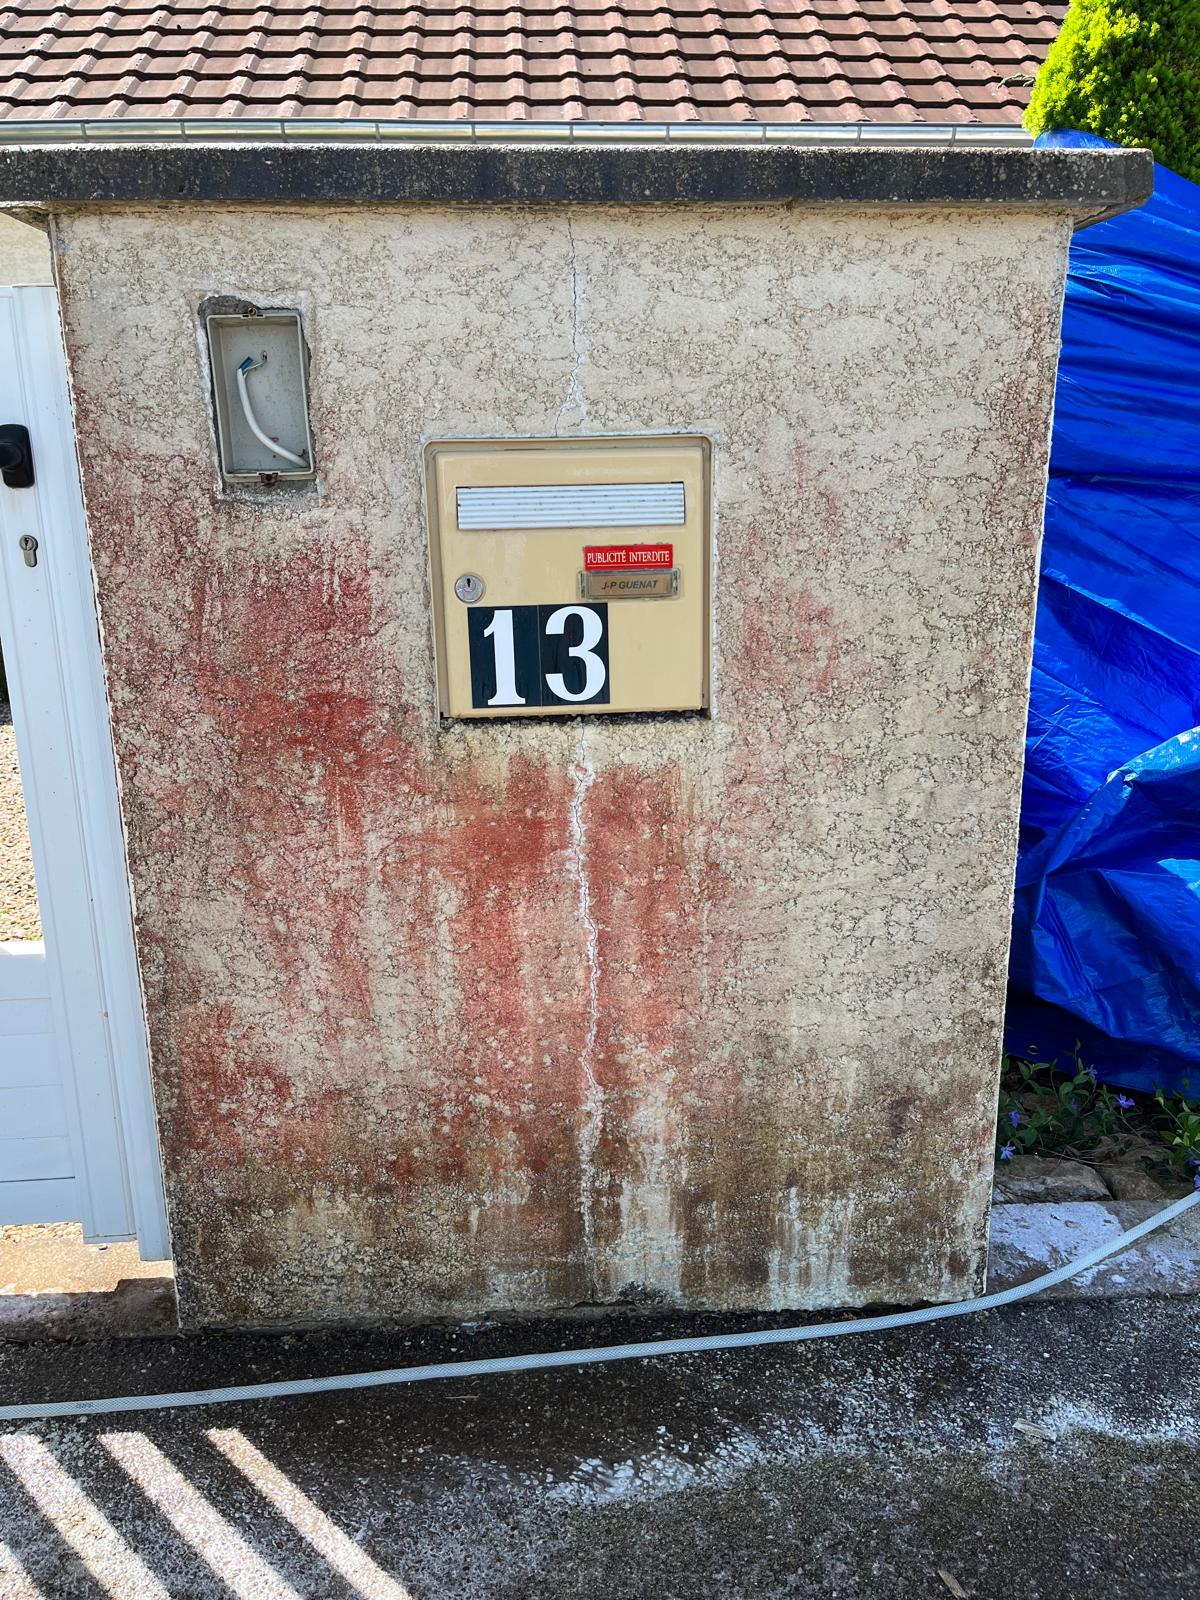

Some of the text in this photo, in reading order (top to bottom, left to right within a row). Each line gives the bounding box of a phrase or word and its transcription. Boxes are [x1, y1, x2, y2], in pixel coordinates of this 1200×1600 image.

[587, 550, 670, 563] PUBLICITÉ INTERDITE
[601, 580, 658, 590] J-P GUENAT
[483, 605, 606, 706] 13
